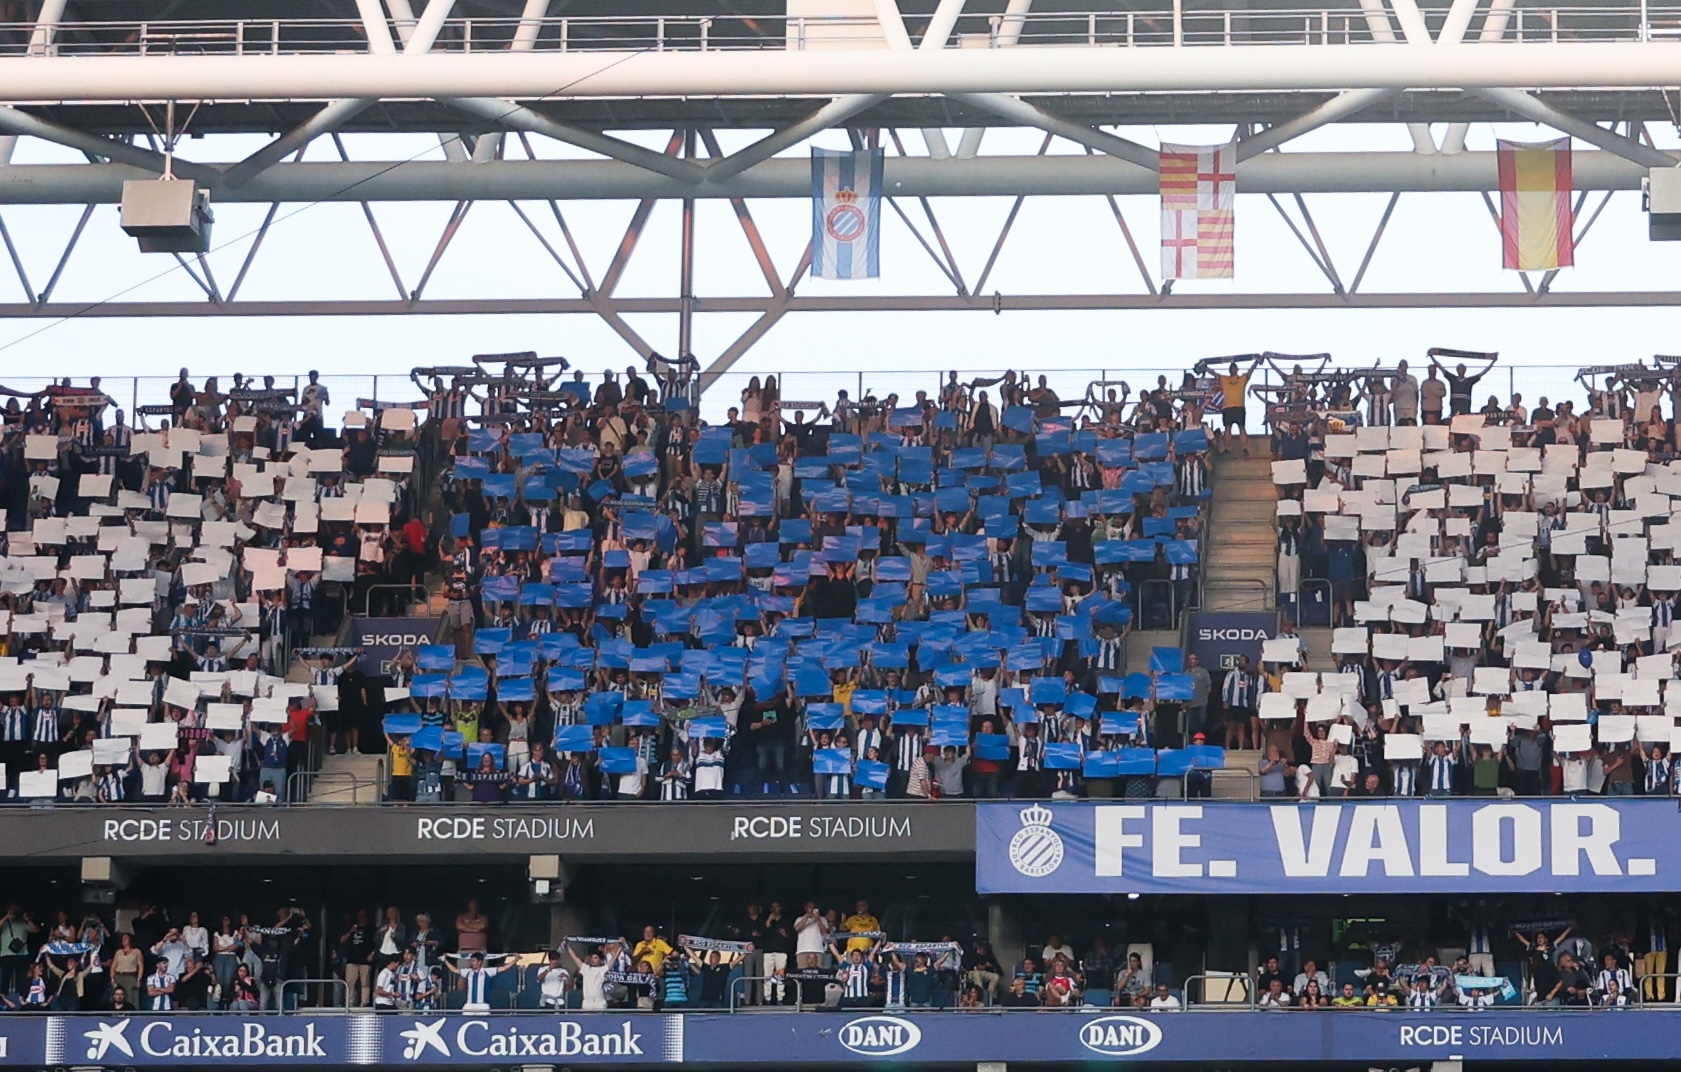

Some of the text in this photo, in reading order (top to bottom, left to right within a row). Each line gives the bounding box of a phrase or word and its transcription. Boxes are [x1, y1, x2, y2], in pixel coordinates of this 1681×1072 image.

[362, 634, 430, 645] SKODA
[1200, 629, 1268, 639] SKODA
[105, 820, 171, 840] RCDE
[418, 818, 593, 838] RCDE STADIUM
[734, 817, 910, 838] RCDE STADIUM
[1095, 806, 1236, 877] FE.
[1273, 804, 1655, 876] VALOR.
[141, 1022, 326, 1056] CaixaBank
[457, 1021, 643, 1055] CaixaBank
[848, 1027, 902, 1046] DANI
[1089, 1026, 1143, 1045] DANI
[1401, 1026, 1562, 1045] RCDE STADIUM
